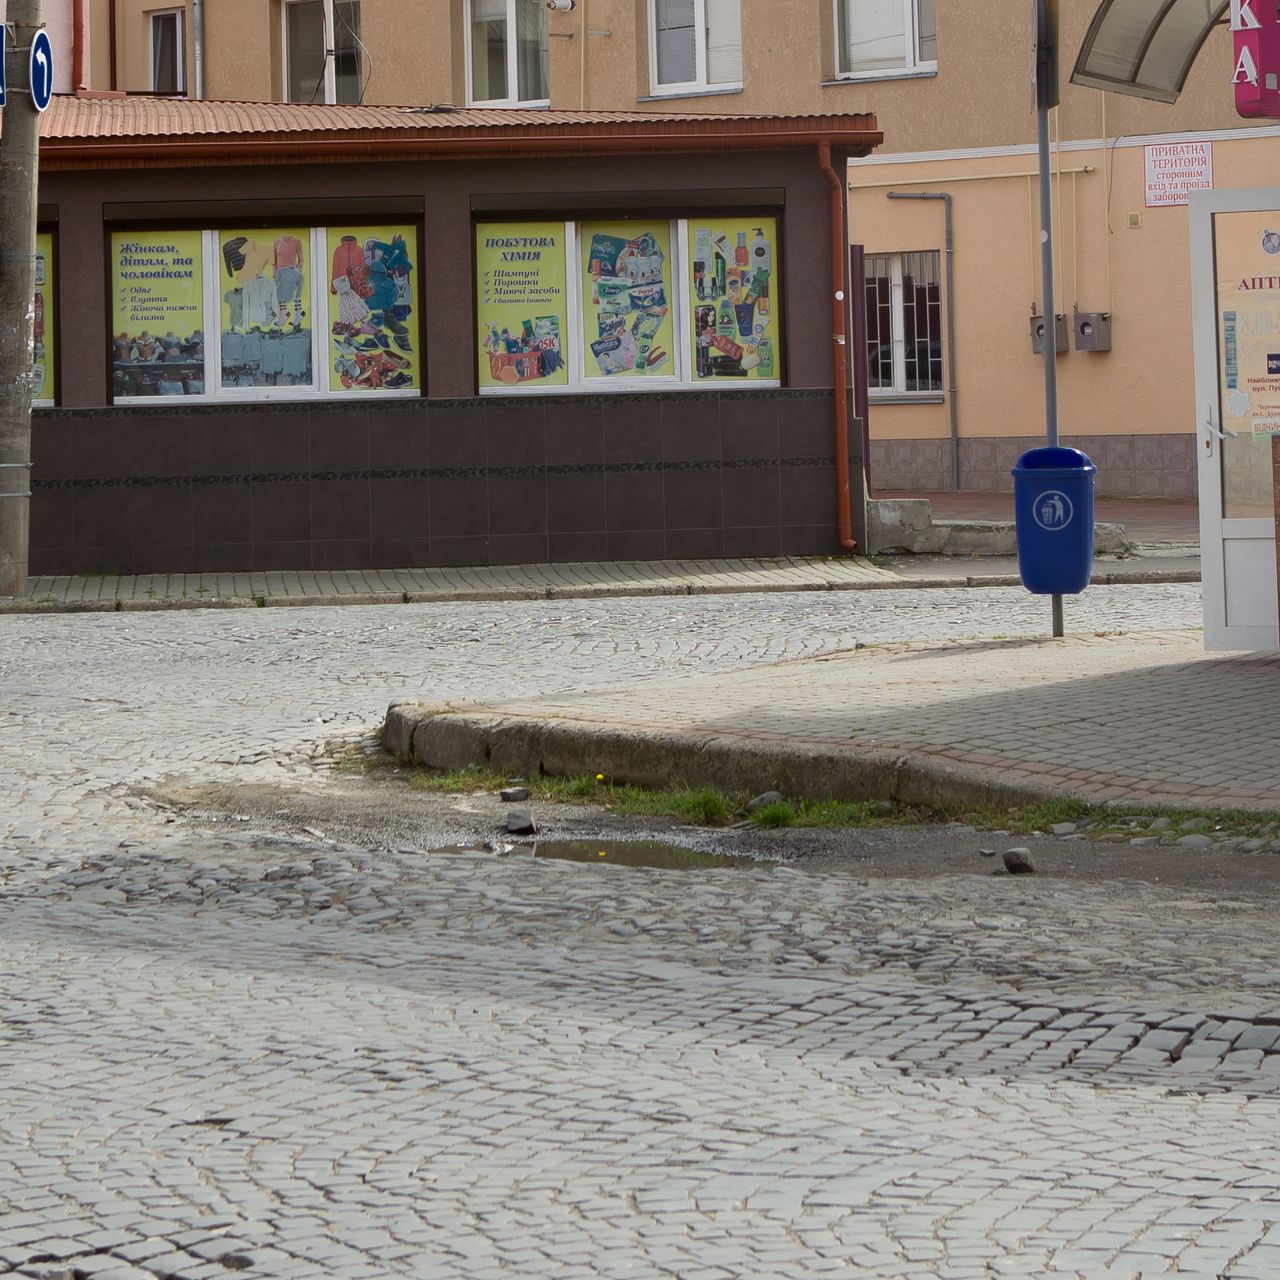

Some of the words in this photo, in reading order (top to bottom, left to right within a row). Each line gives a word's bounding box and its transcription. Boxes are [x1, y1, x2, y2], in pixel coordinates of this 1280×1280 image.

[1151, 144, 1205, 157] ПРИВАТНА
[1151, 156, 1207, 169] ТЕРИТОРІЯ
[1156, 169, 1203, 181] стороннім
[1148, 181, 1166, 191] вхід
[1180, 179, 1210, 192] проїзд
[485, 237, 556, 248] ПОБУТОВА
[120, 255, 168, 267] дітям,
[172, 257, 193, 266] та
[500, 251, 541, 261] ХІМІЯ
[120, 267, 193, 279] чоловікам
[493, 269, 540, 278] Шампуні
[493, 279, 539, 288] Порошки
[130, 286, 151, 294] Одяг
[493, 286, 526, 295] Миючі
[527, 286, 561, 294] засоби
[130, 296, 168, 304] Взуття
[130, 304, 164, 312] Жіноча
